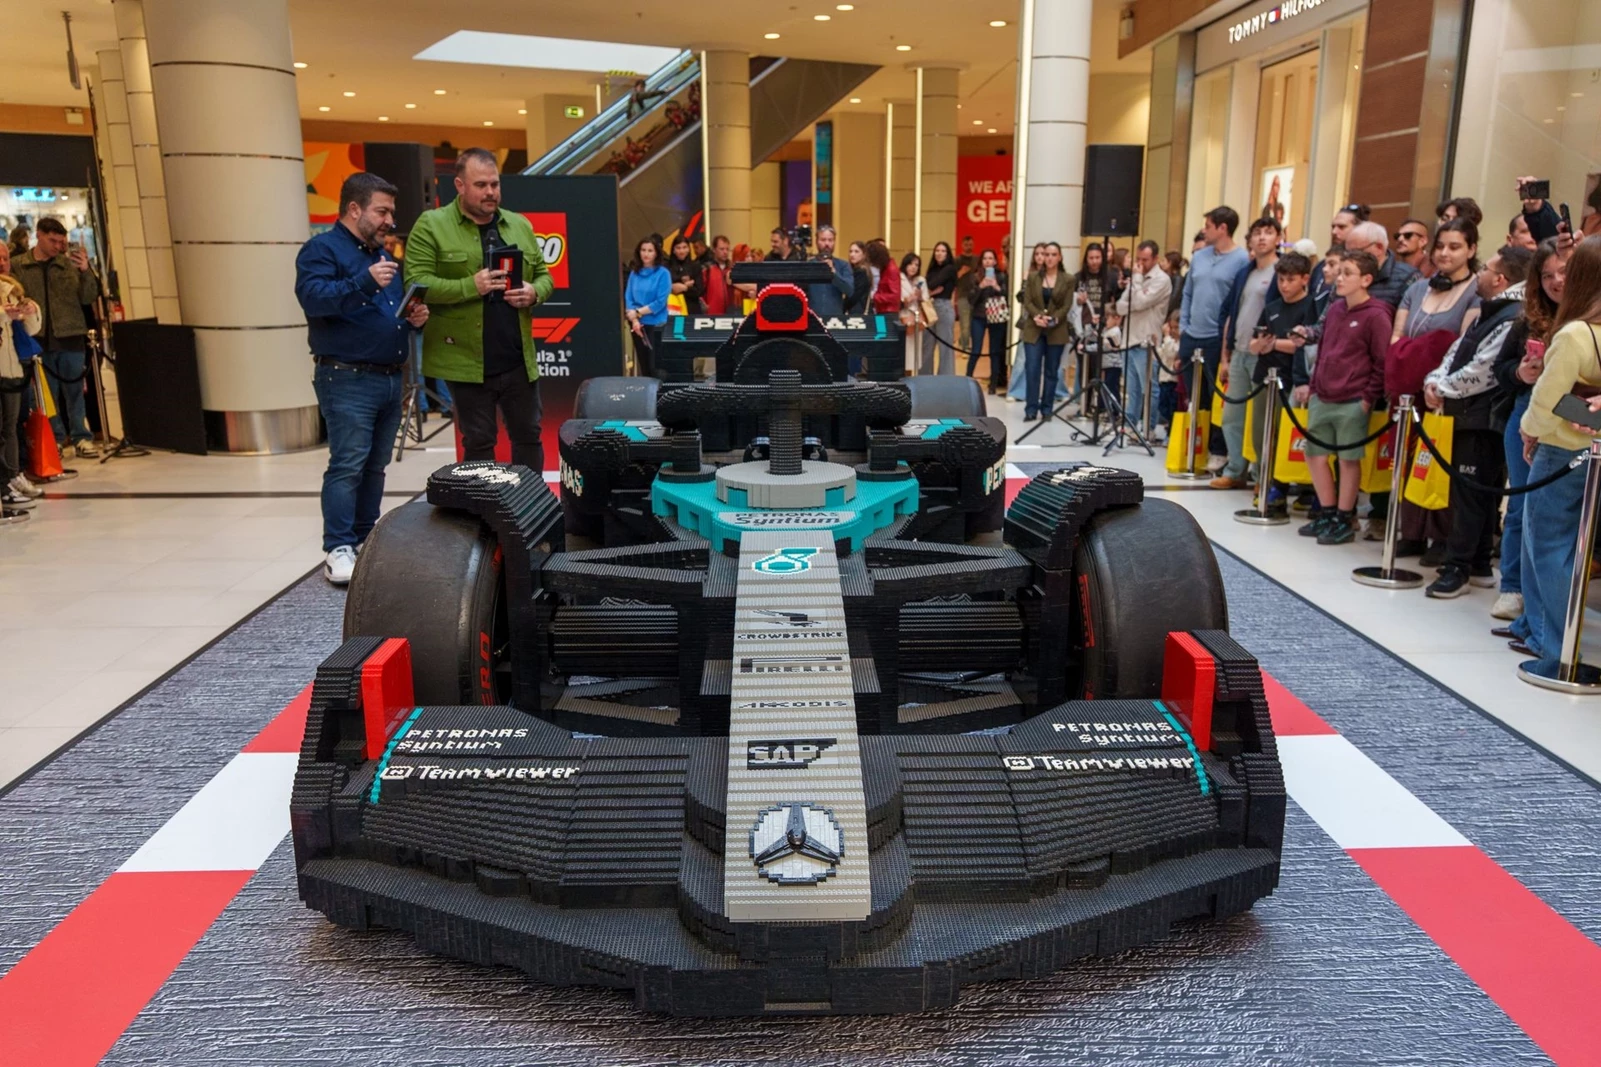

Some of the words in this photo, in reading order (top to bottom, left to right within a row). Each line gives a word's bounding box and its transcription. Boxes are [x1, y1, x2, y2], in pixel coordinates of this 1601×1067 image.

[1228, 12, 1267, 44] TOMMY
[969, 181, 993, 193] WE
[538, 363, 570, 376] tion
[735, 516, 840, 526] Syntium
[737, 631, 844, 641] CROWDSTRIKE
[405, 728, 529, 739] PETRONAS
[1051, 722, 1173, 733] PETRONAS
[1079, 733, 1183, 746] Syntium
[396, 740, 502, 752] Syntium
[748, 742, 823, 766] SAP
